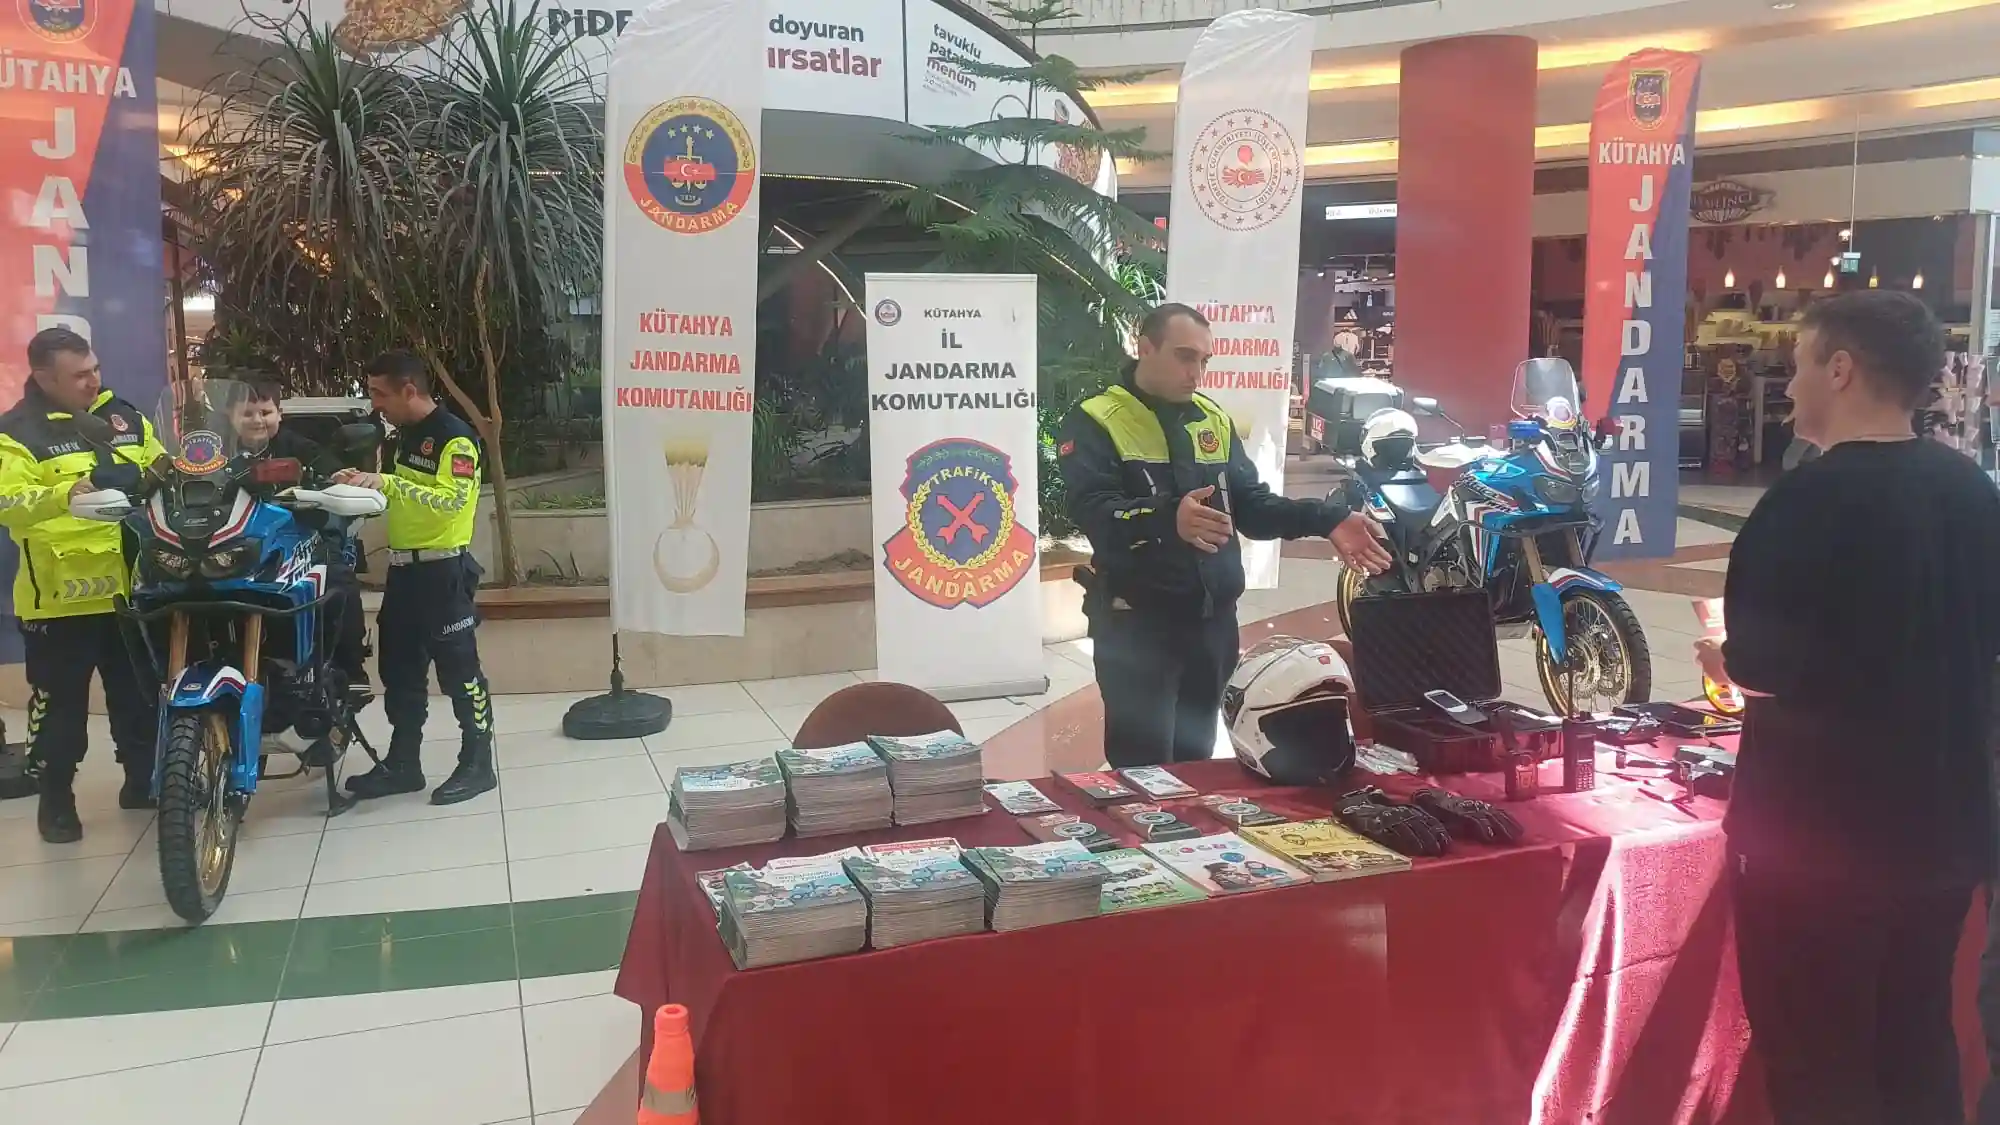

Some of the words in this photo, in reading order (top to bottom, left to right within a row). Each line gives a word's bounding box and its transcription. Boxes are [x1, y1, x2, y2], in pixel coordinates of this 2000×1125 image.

[769, 14, 865, 43] doyuran
[933, 23, 982, 60] tavuklu
[0, 48, 137, 99] ÜTAHYA
[767, 47, 882, 78] ırsatlar
[1598, 137, 1686, 165] KÜTAHYA
[640, 197, 739, 232] JANDARMA
[639, 308, 733, 337] KÜTAHYA
[924, 307, 982, 319] KÜTAHYA
[941, 329, 963, 349] İL
[1210, 337, 1280, 357] NDARMA
[630, 350, 741, 375] JANDARMA
[884, 362, 1017, 380] JANDARMA
[1610, 174, 1654, 546] JANDARMA
[1197, 366, 1290, 390] MUTANLIĞI
[617, 387, 752, 413] KOMUTANLIĞI
[872, 388, 1036, 411] KOMUTANLIĞI
[895, 548, 1029, 600] JANDARMA
